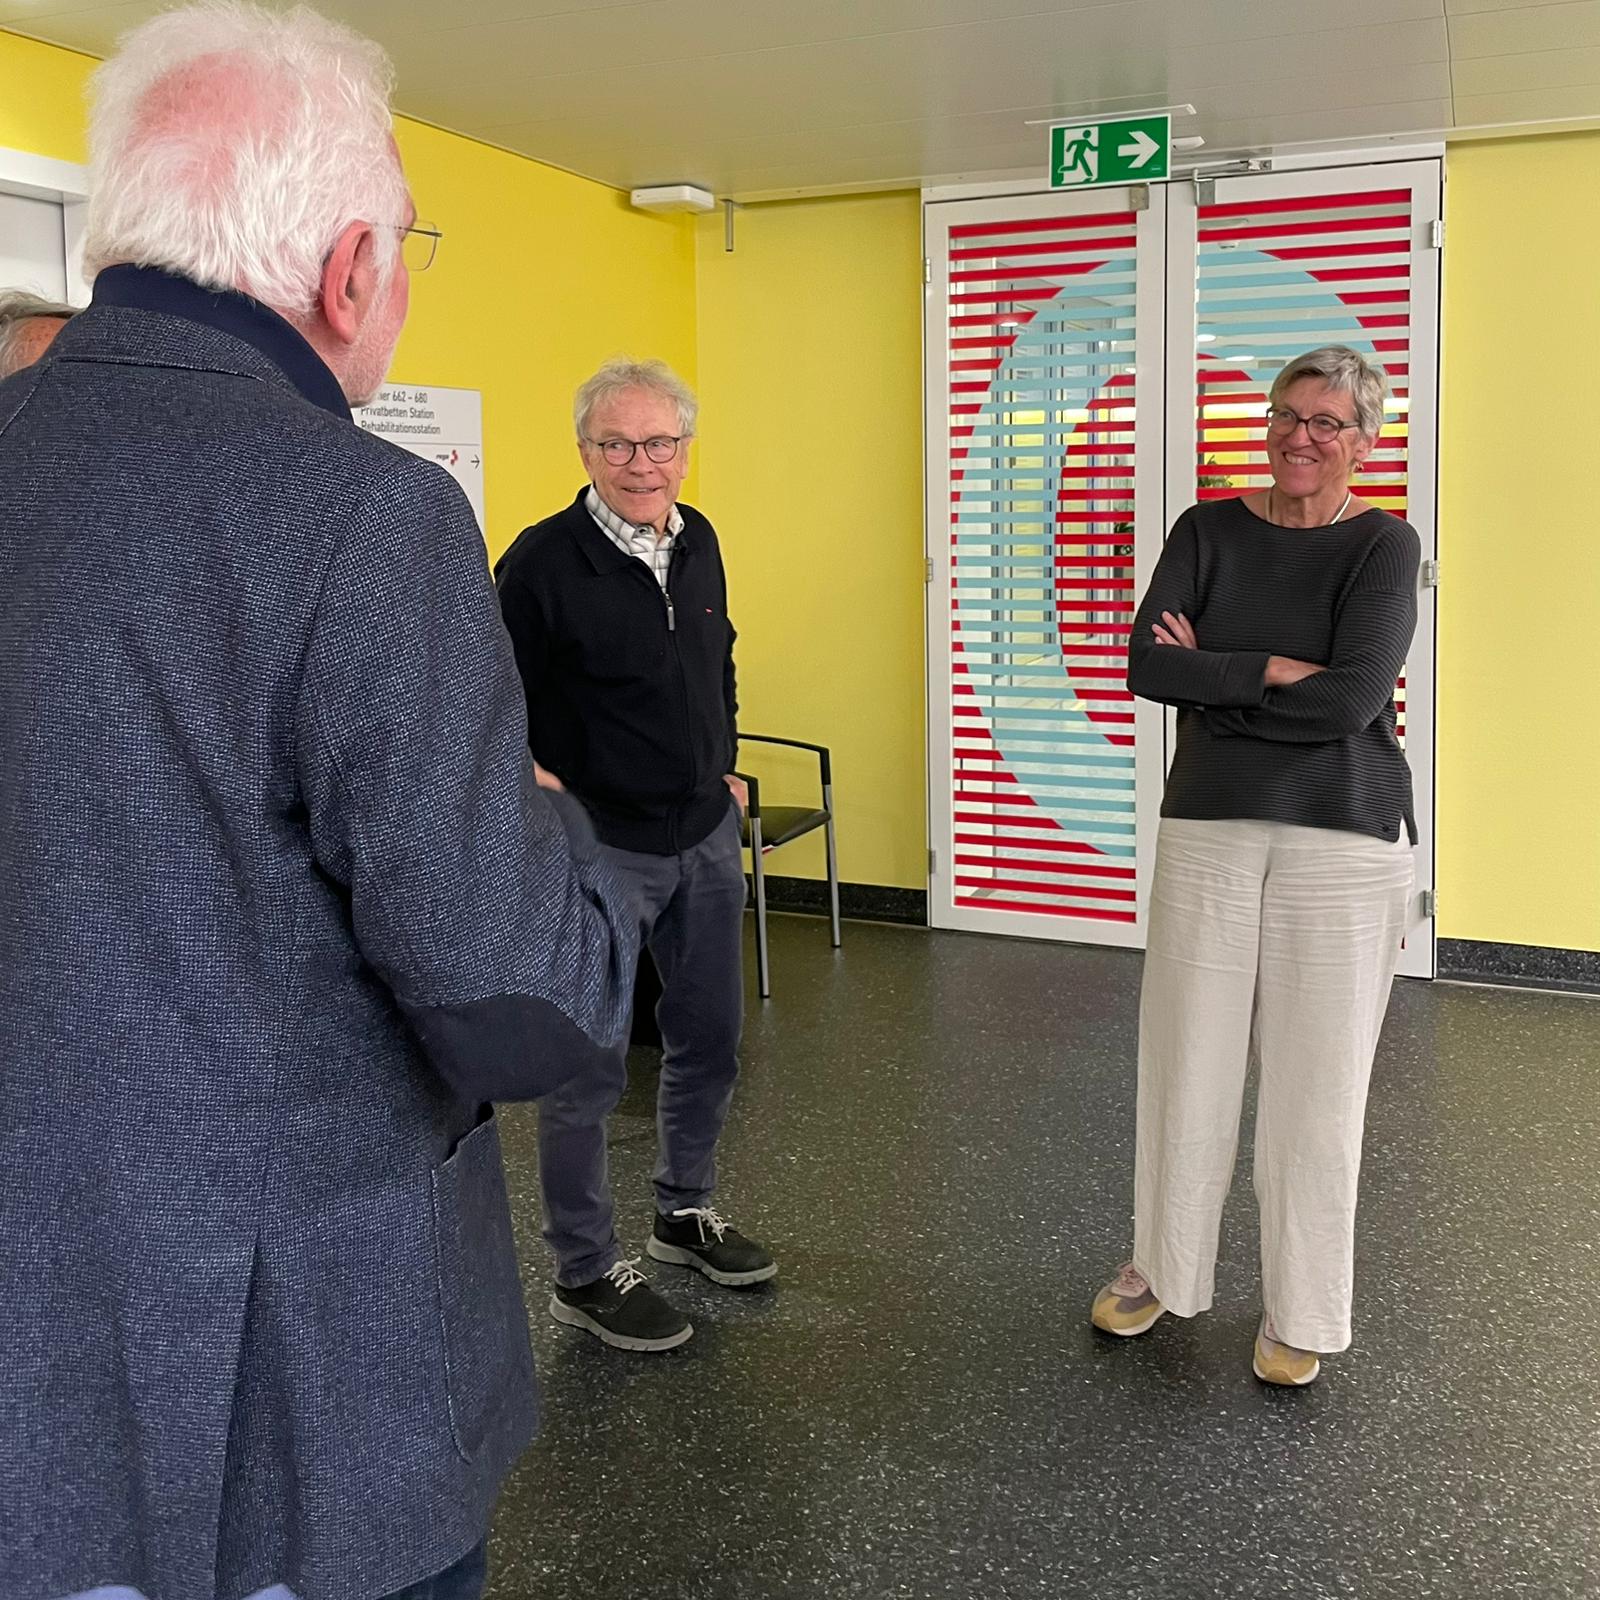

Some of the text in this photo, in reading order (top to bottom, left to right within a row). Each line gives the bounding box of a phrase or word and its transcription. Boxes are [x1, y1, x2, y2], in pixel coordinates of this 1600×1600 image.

[392, 391, 406, 402] 662
[414, 392, 428, 403] 680
[360, 406, 435, 420] Privatbetten Station
[360, 420, 441, 434] Rehabilitationsstation
